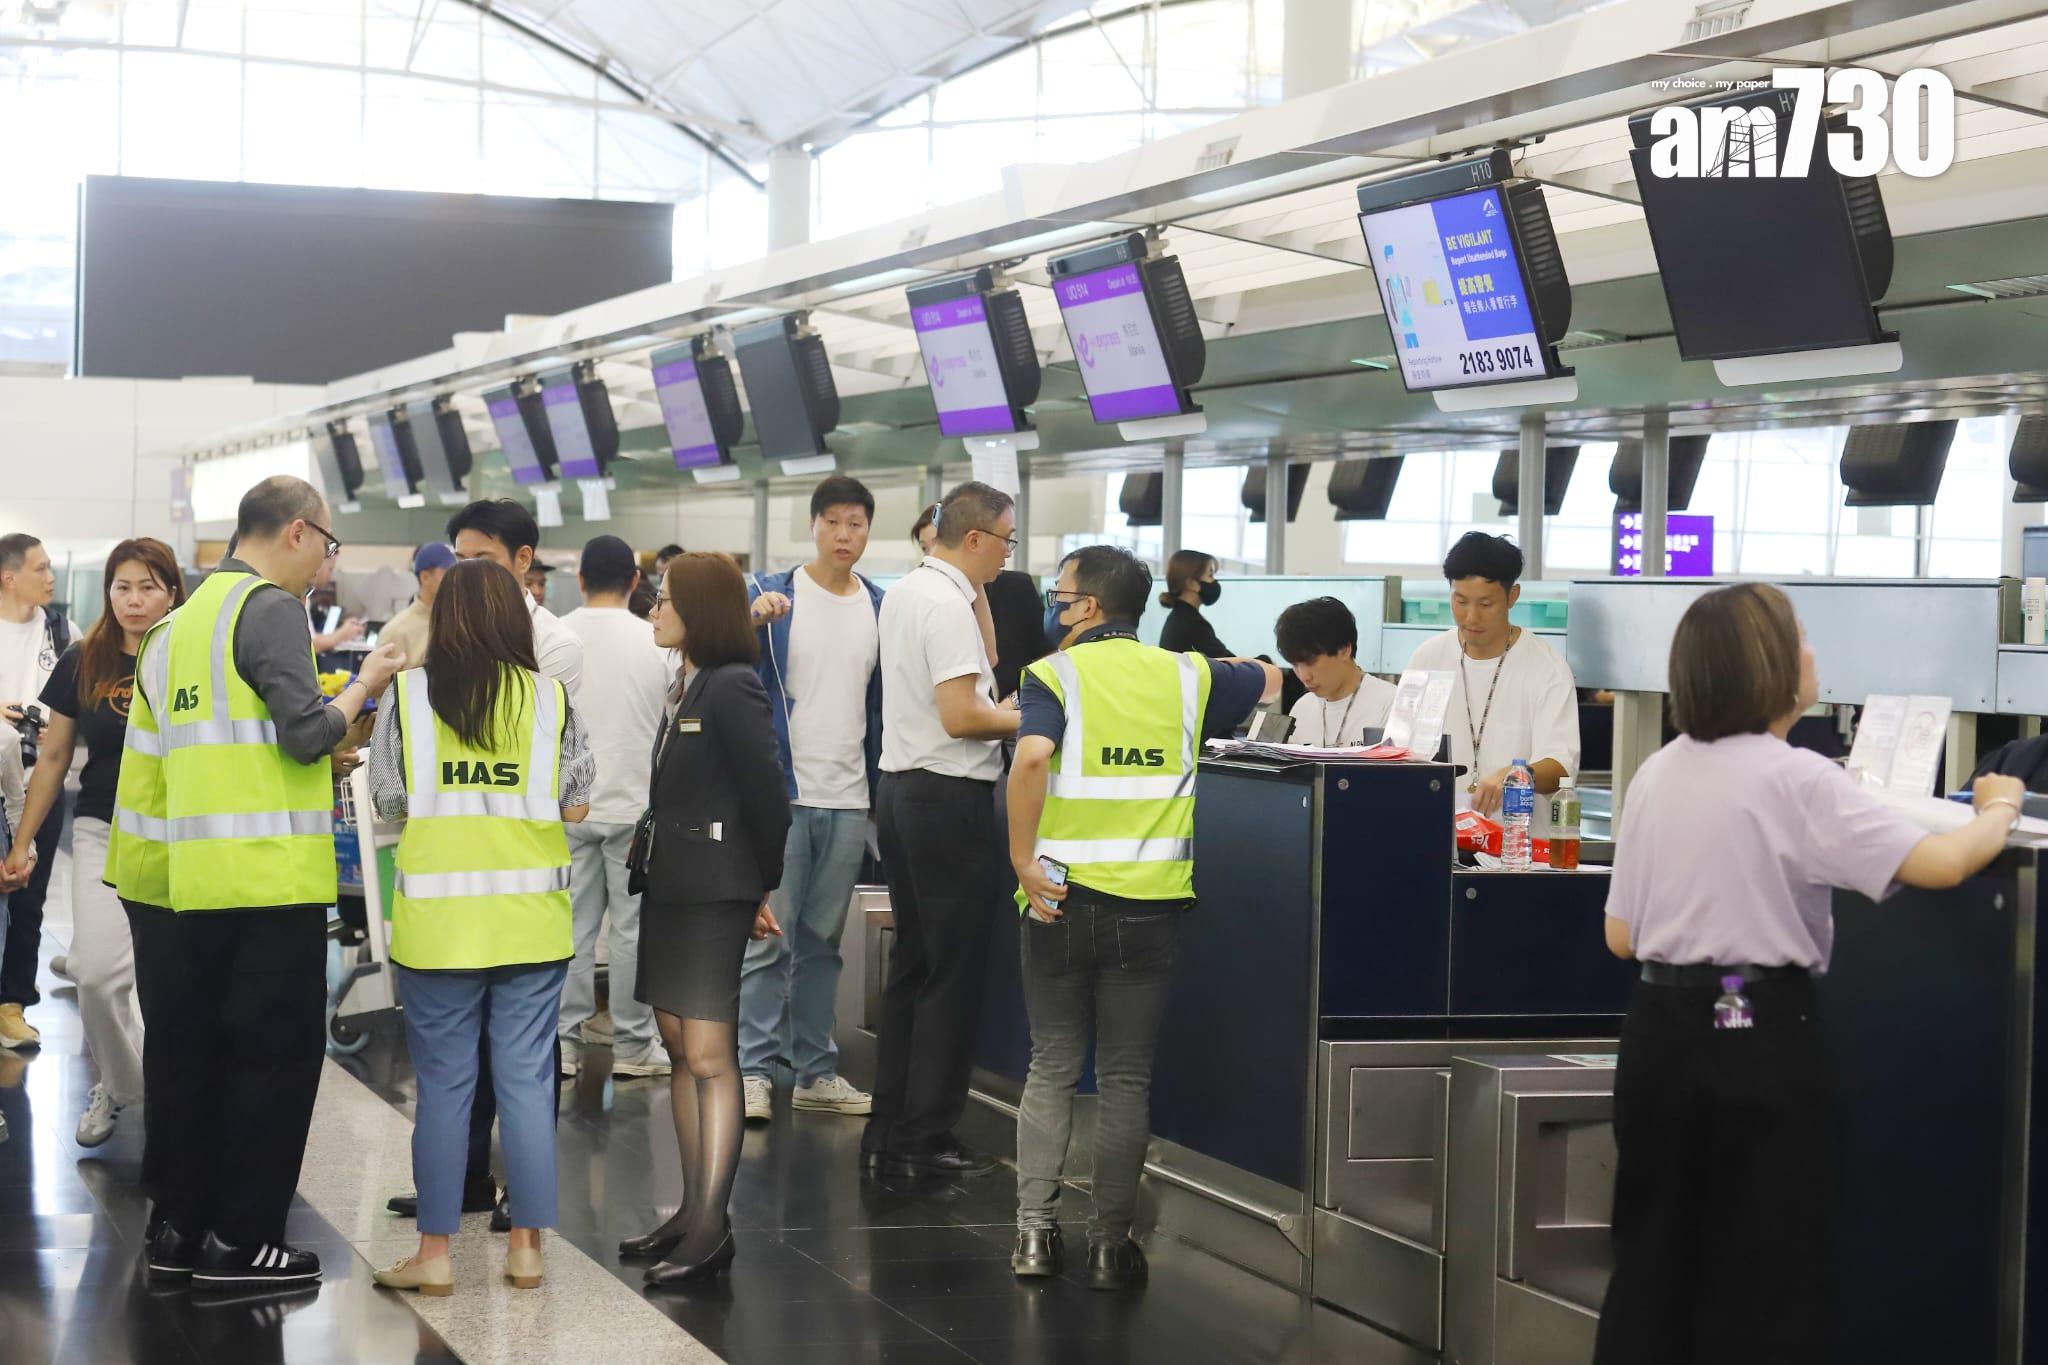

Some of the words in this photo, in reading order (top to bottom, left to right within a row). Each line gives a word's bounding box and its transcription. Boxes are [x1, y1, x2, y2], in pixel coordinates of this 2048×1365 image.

[1471, 161, 1492, 183] H10
[1445, 235, 1457, 251] BE
[1457, 229, 1493, 249] VIGILANT
[1450, 253, 1467, 267] Report
[1467, 250, 1494, 263] Unattended
[1493, 248, 1508, 260] Bags
[1459, 350, 1495, 375] 2183
[1496, 345, 1533, 371] 9074
[1102, 747, 1164, 767] HAS
[442, 761, 520, 786] HAS
[1471, 834, 1489, 849] Yes
